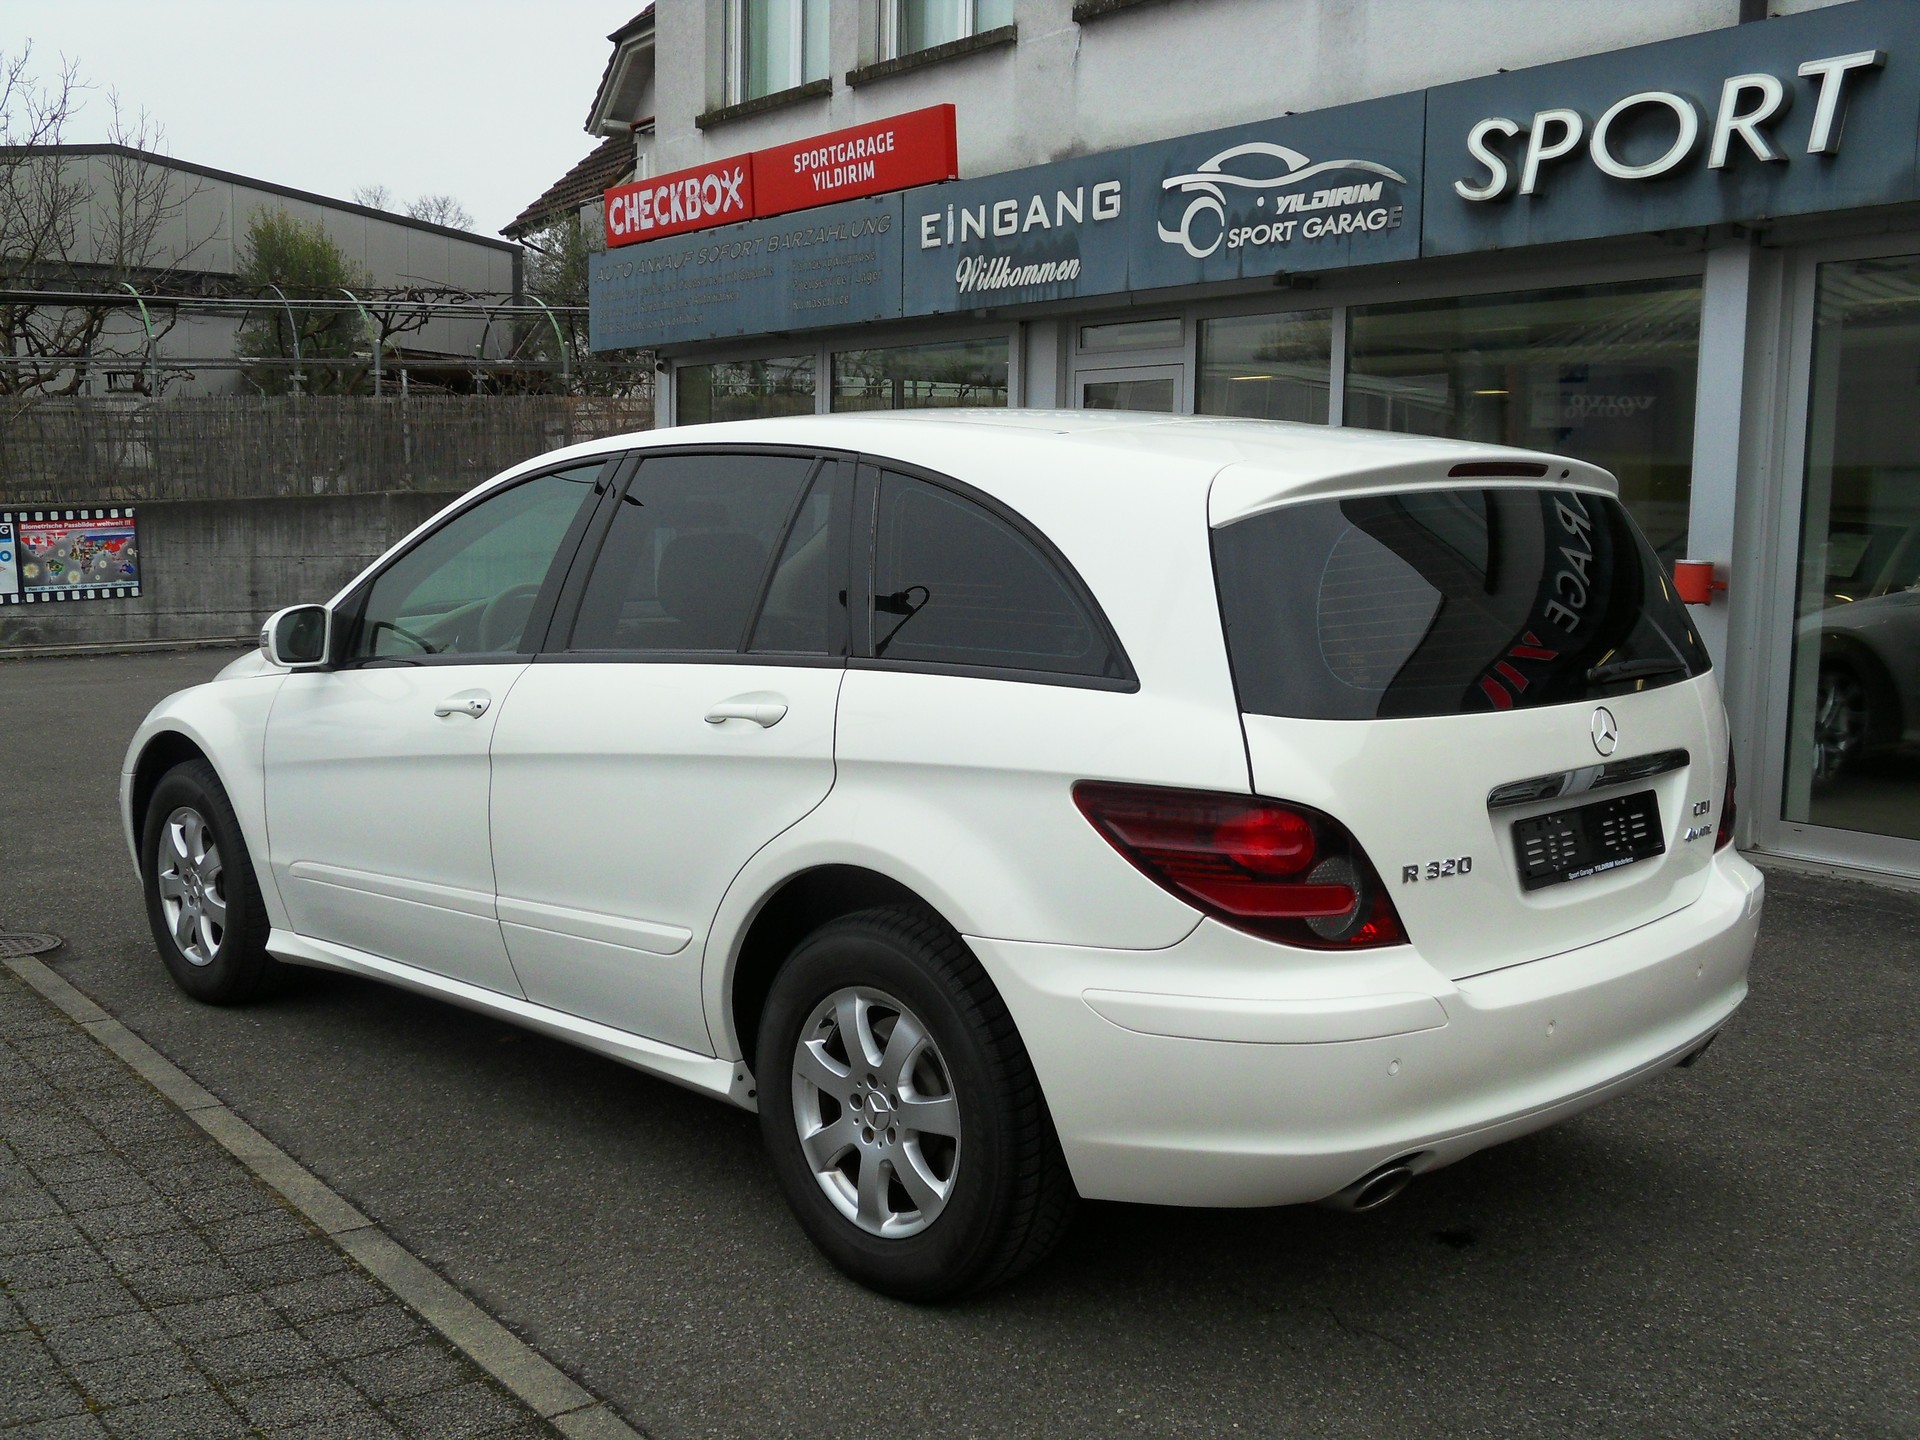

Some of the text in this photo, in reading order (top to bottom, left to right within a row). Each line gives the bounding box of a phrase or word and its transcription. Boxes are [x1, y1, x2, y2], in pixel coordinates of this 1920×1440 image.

[1454, 48, 1886, 202] SPORT
[793, 131, 895, 173] SPORTGARAGE
[812, 159, 875, 191] YILDIRIM
[609, 166, 744, 235] CHECKBOX
[1276, 181, 1383, 215] YILDIRIM
[1227, 205, 1403, 249] SPORT GARAGE
[595, 215, 892, 283] AUTO ANKAUF SOFORT BARZAHLUNG
[955, 254, 1081, 294] Willkommen
[21, 522, 62, 531] Biometrische
[64, 521, 96, 529] Passbilder
[1402, 856, 1472, 884] R 320
